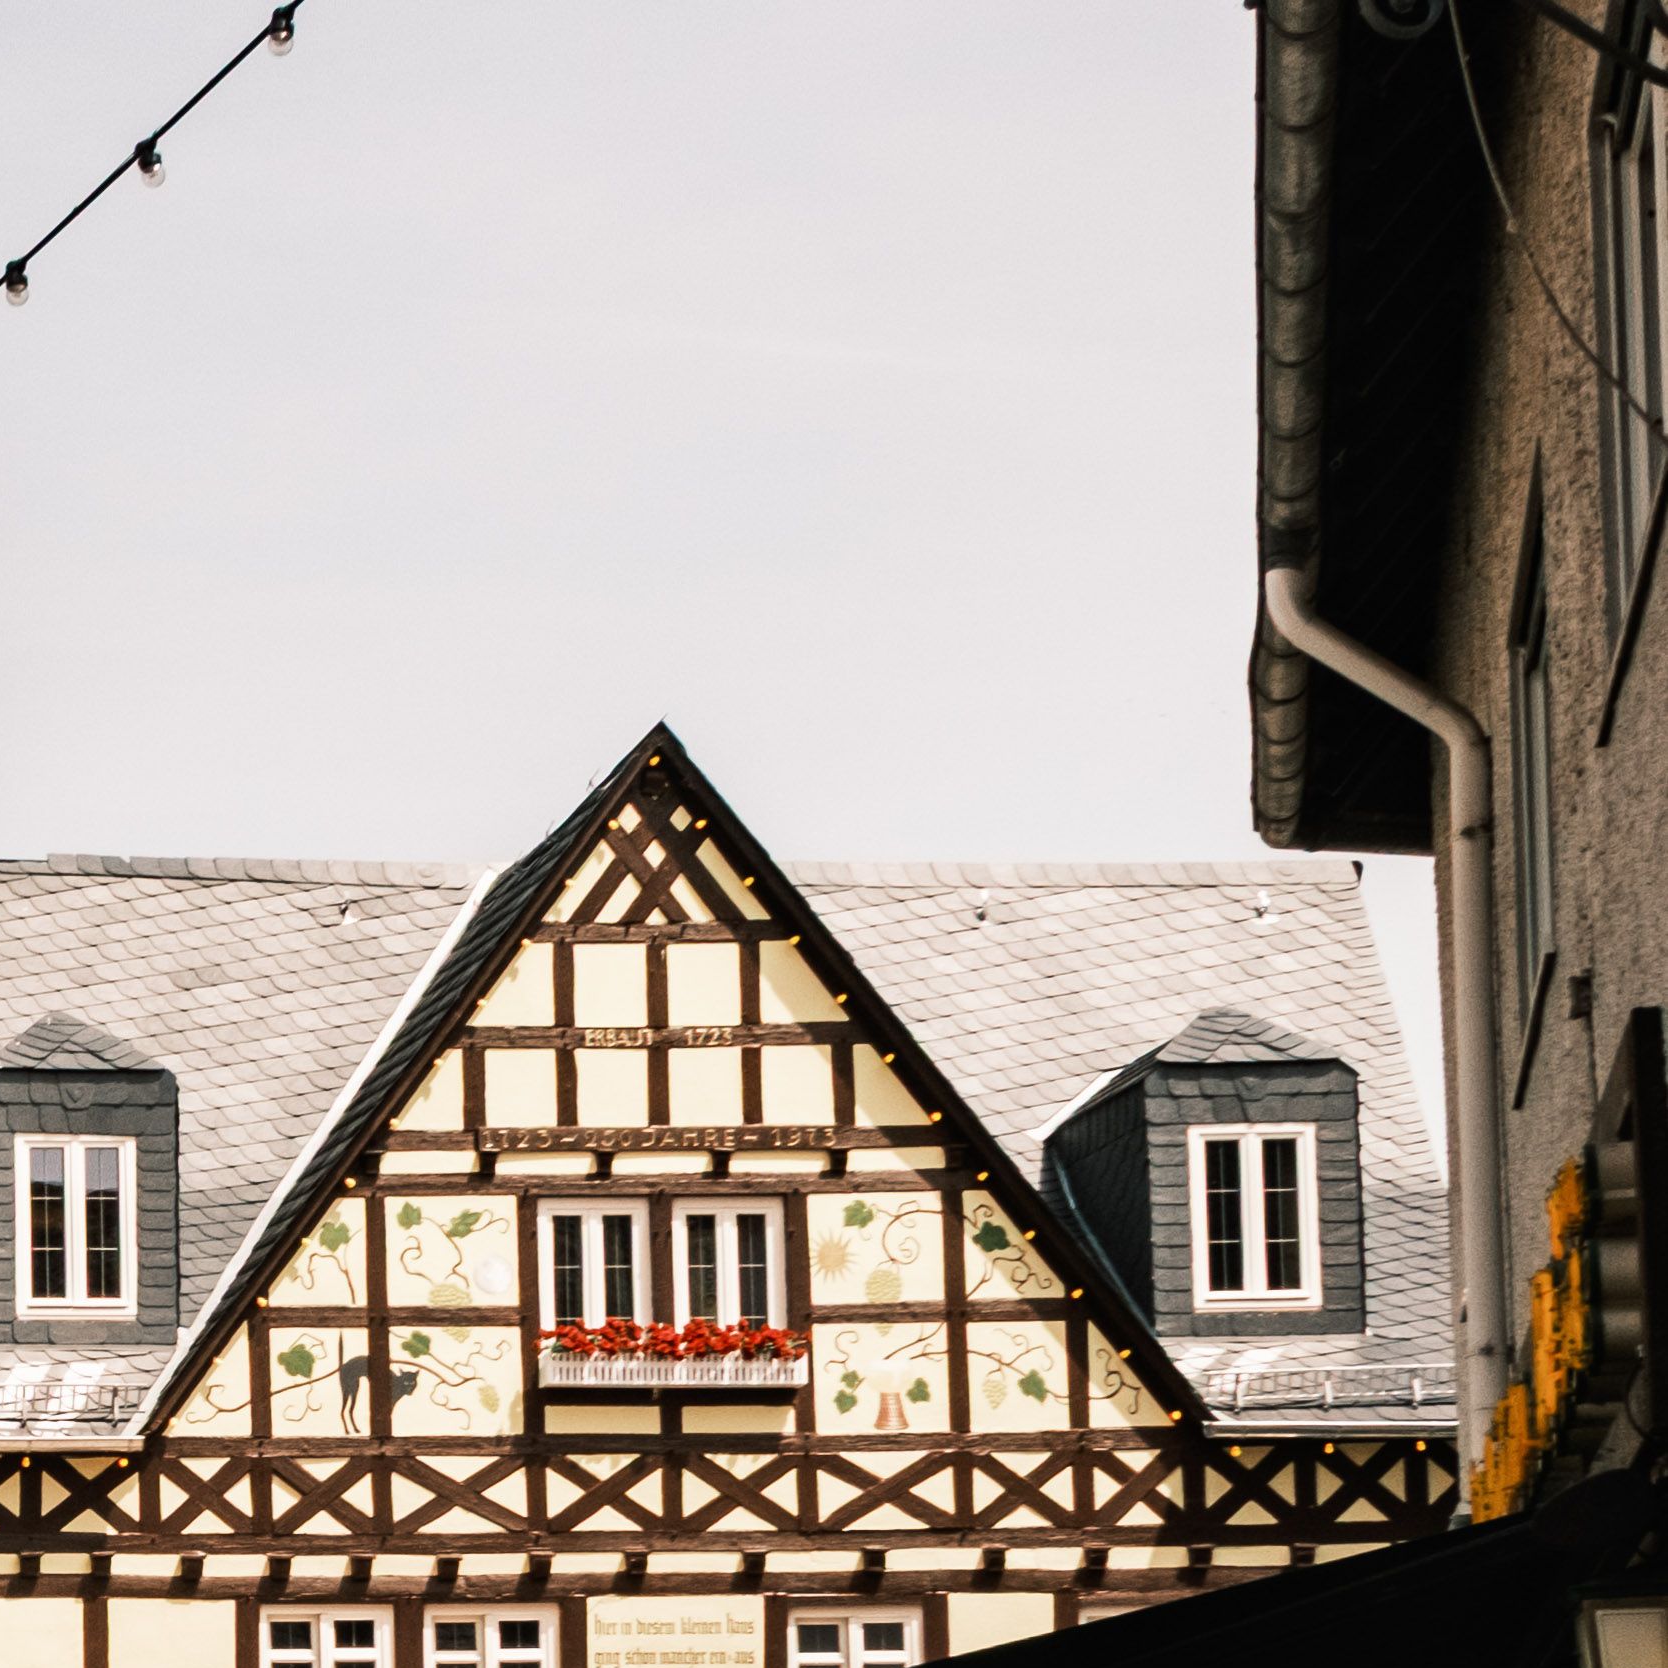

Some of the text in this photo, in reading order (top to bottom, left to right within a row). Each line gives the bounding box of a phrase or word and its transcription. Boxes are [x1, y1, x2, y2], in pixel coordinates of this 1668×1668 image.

[584, 1028, 733, 1047] ERBAUT 1723
[482, 1128, 553, 1149] 1723
[584, 1128, 633, 1149] 250
[642, 1127, 736, 1149] JAHRE
[770, 1127, 839, 1148] 1973
